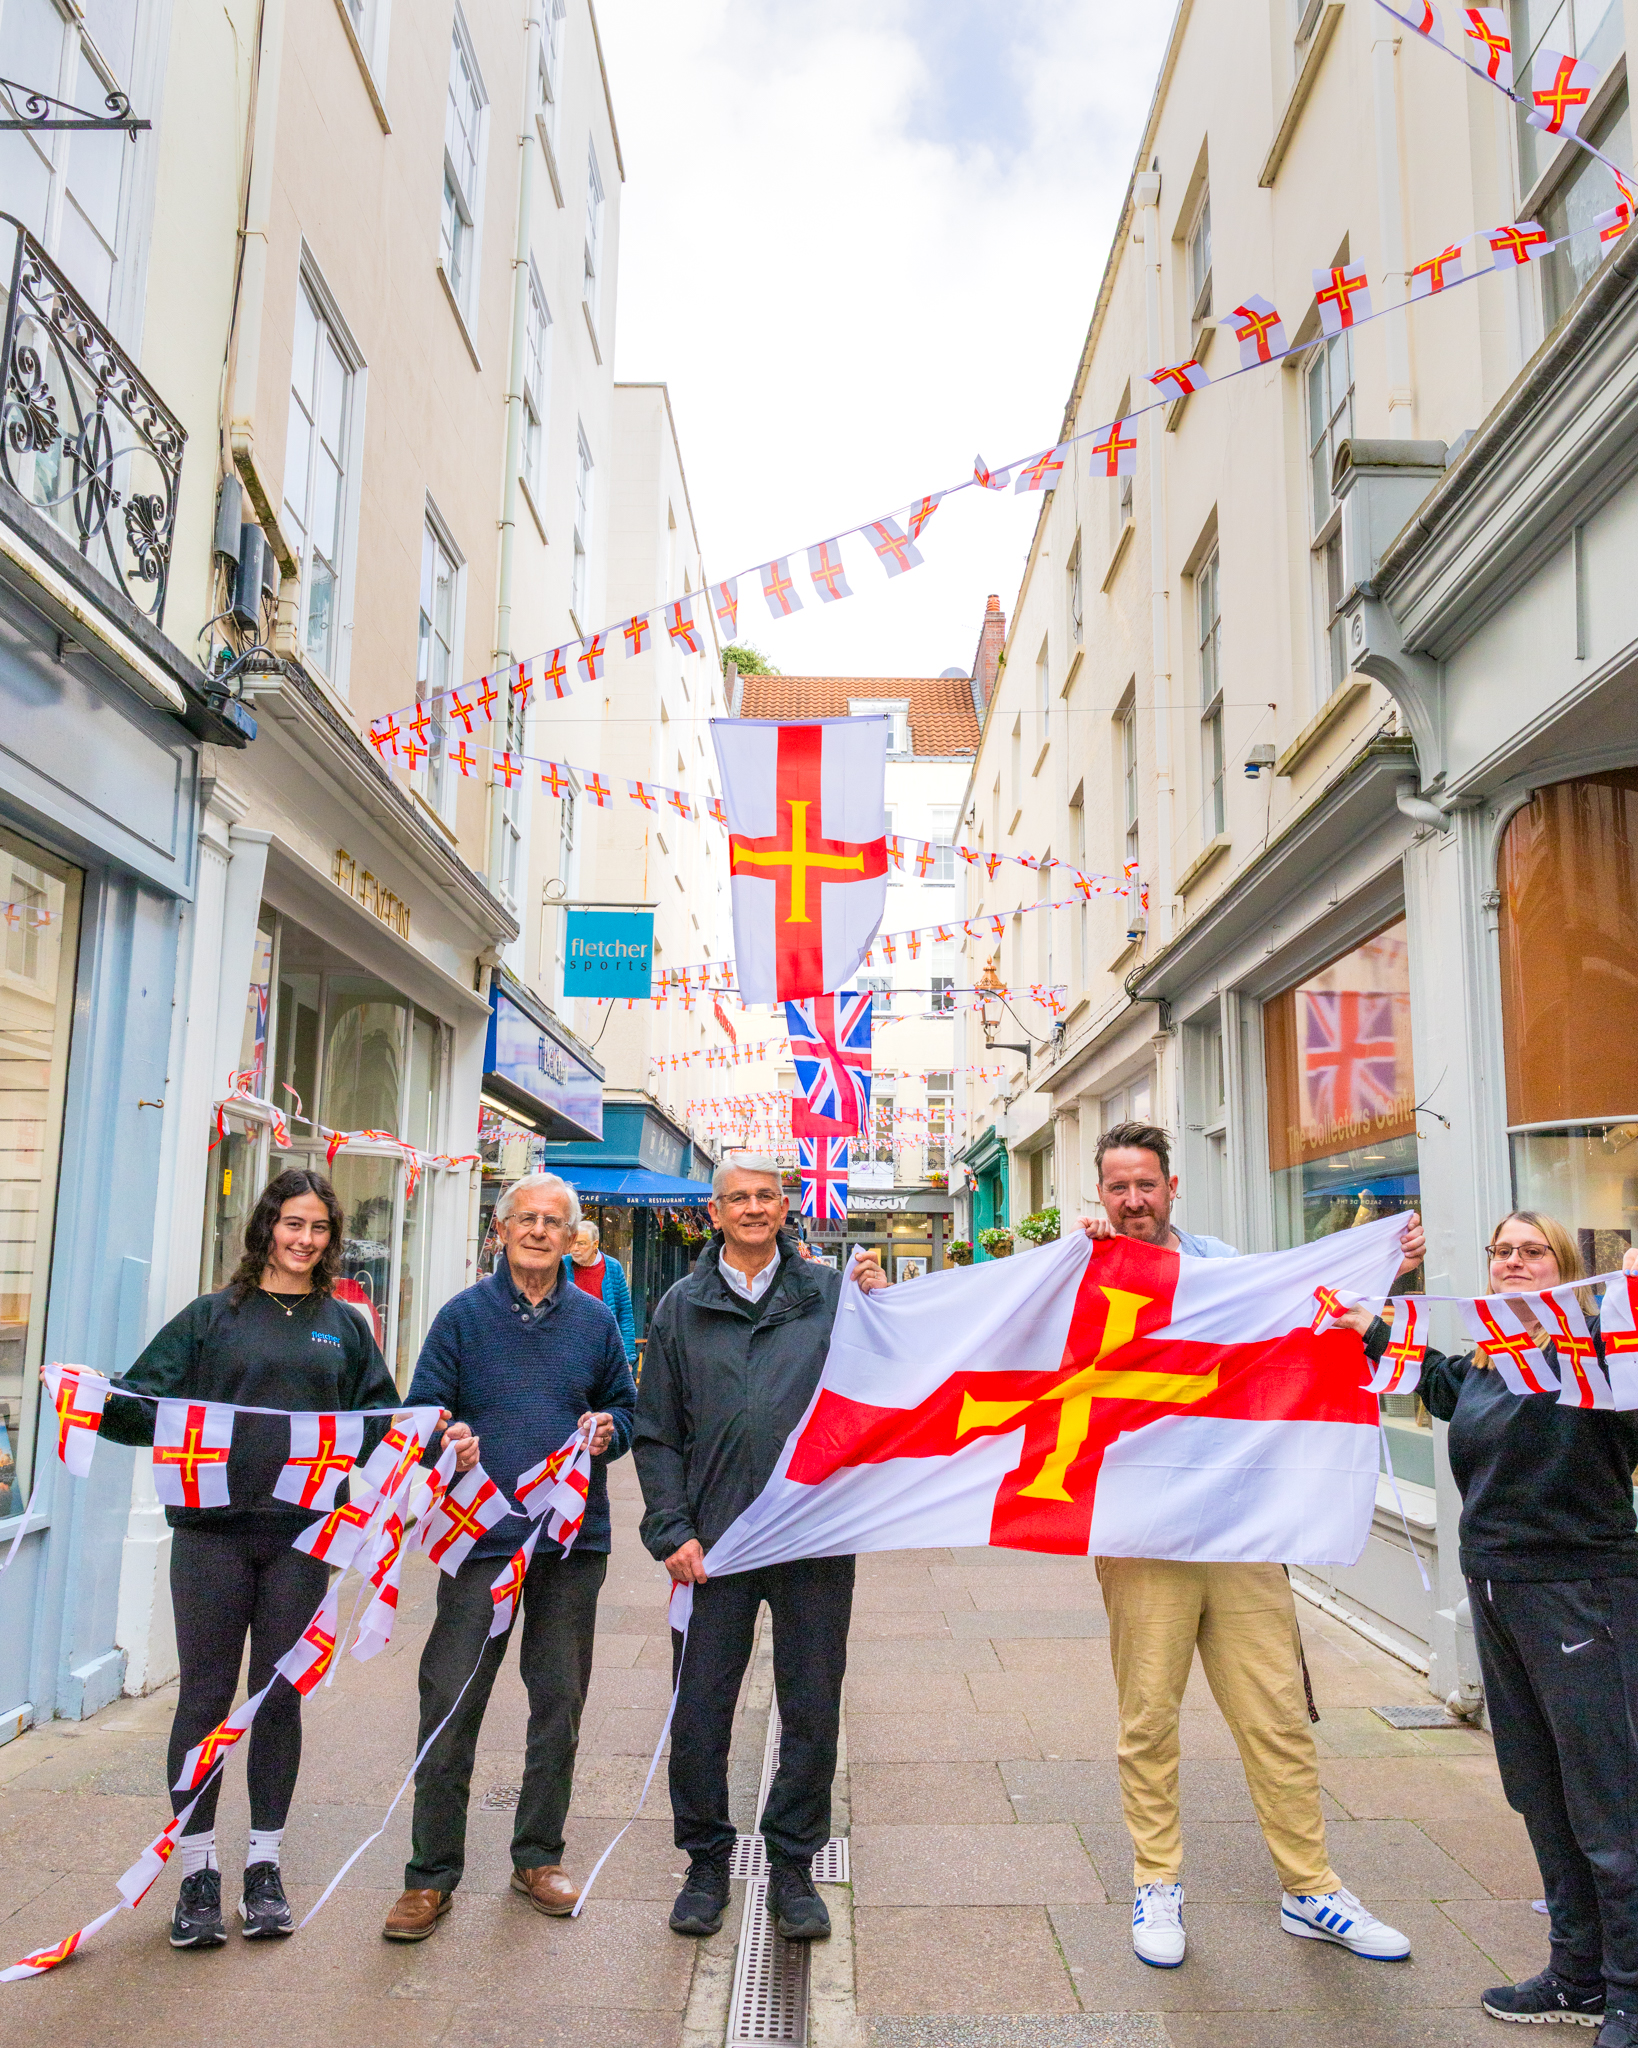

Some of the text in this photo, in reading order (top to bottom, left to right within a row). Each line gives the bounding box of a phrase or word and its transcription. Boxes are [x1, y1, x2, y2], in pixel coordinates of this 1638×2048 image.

[571, 938, 648, 958] fletcher
[570, 960, 647, 972] sports
[1287, 1126, 1306, 1155] The
[1308, 1108, 1371, 1149] Collectors
[1374, 1088, 1415, 1130] Centr
[580, 1194, 600, 1202] CAFÉ
[697, 1196, 712, 1204] SALO
[847, 1195, 910, 1210] NI&GUY
